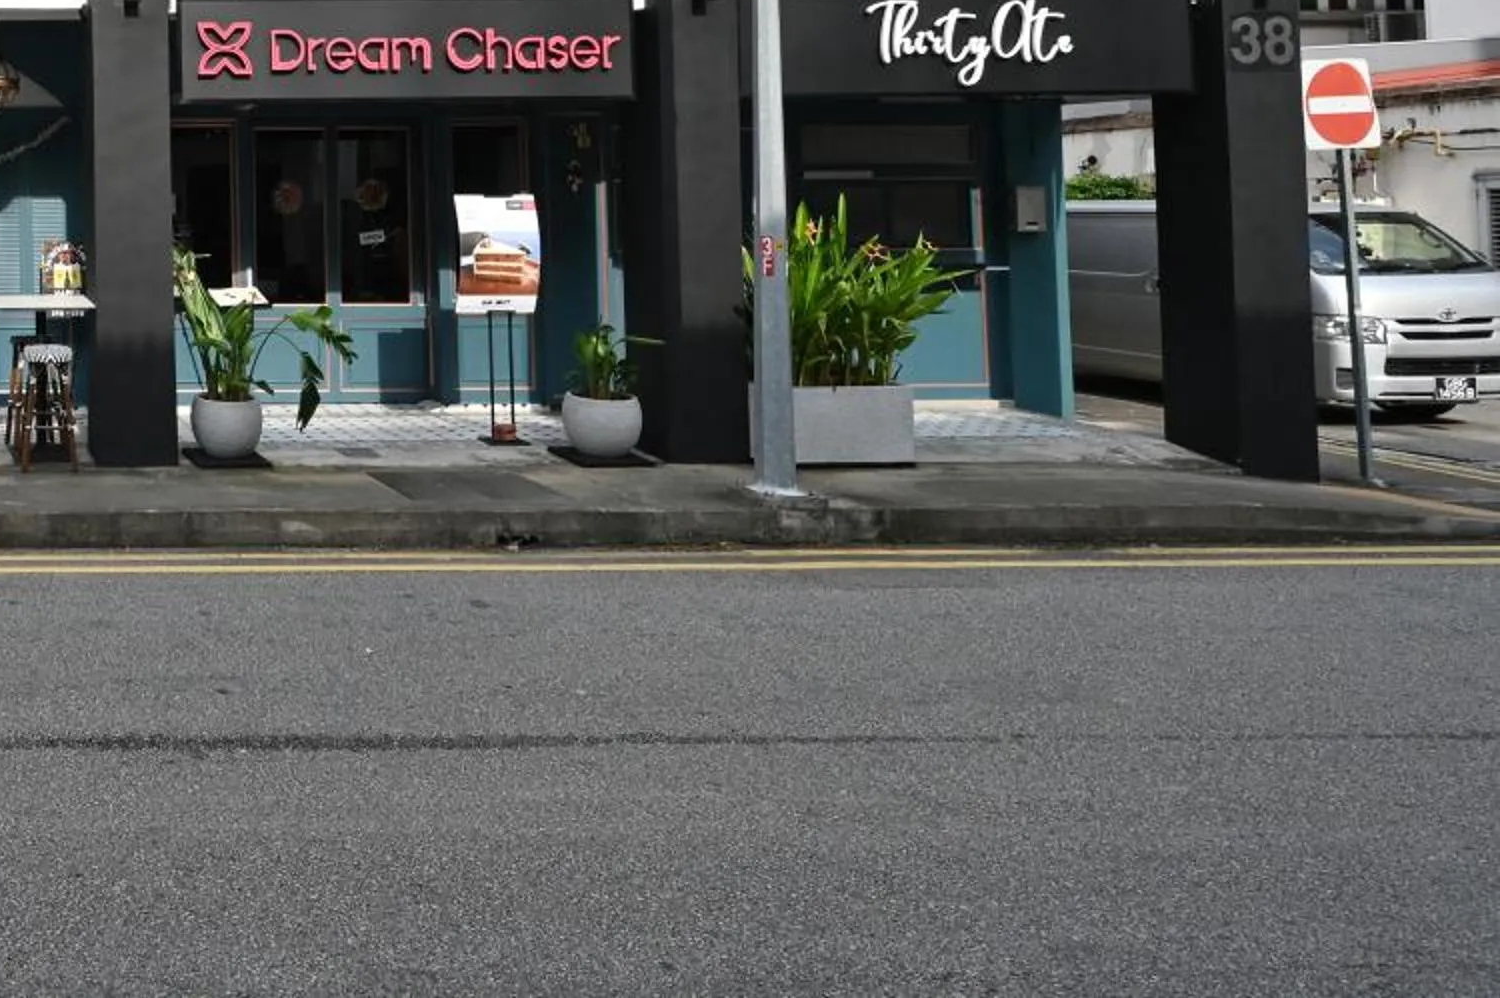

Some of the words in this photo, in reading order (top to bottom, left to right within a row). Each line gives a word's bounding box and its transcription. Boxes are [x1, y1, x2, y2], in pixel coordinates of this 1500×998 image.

[269, 28, 433, 74] Dream
[445, 26, 622, 73] Chaser
[864, 0, 991, 86] Thirty
[1230, 15, 1295, 65] 38
